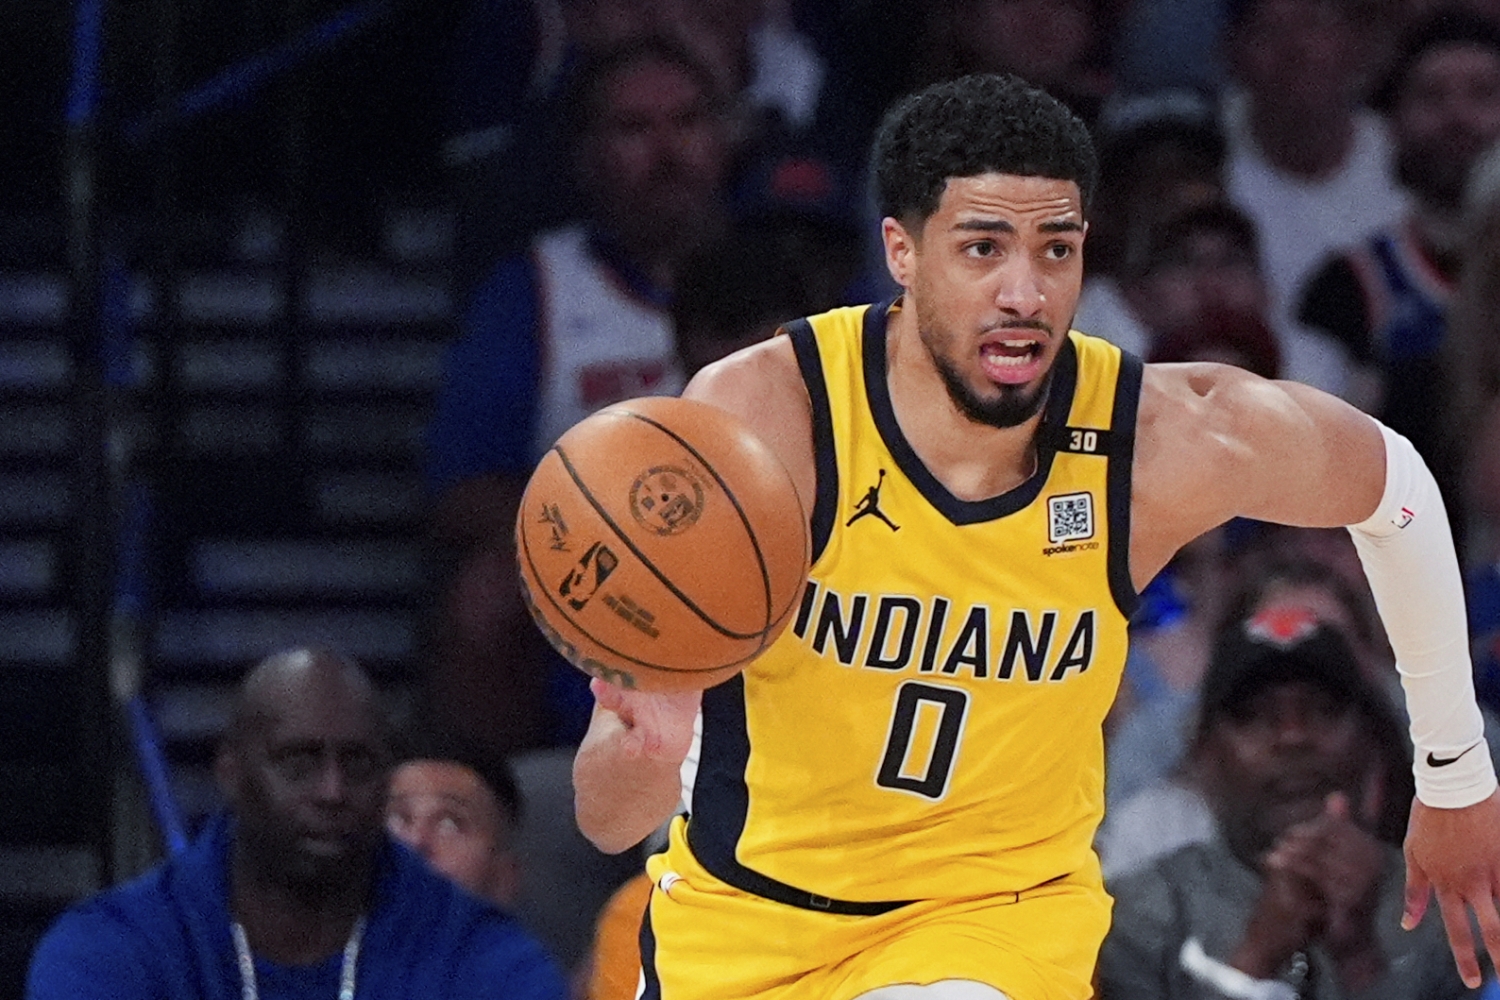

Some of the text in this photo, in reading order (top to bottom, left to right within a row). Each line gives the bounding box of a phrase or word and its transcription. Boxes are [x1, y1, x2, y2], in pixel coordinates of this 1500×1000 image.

[1069, 430, 1098, 452] 30
[1043, 541, 1099, 557] spokenote
[792, 578, 1096, 684] INDIANA
[874, 678, 972, 803] 0
